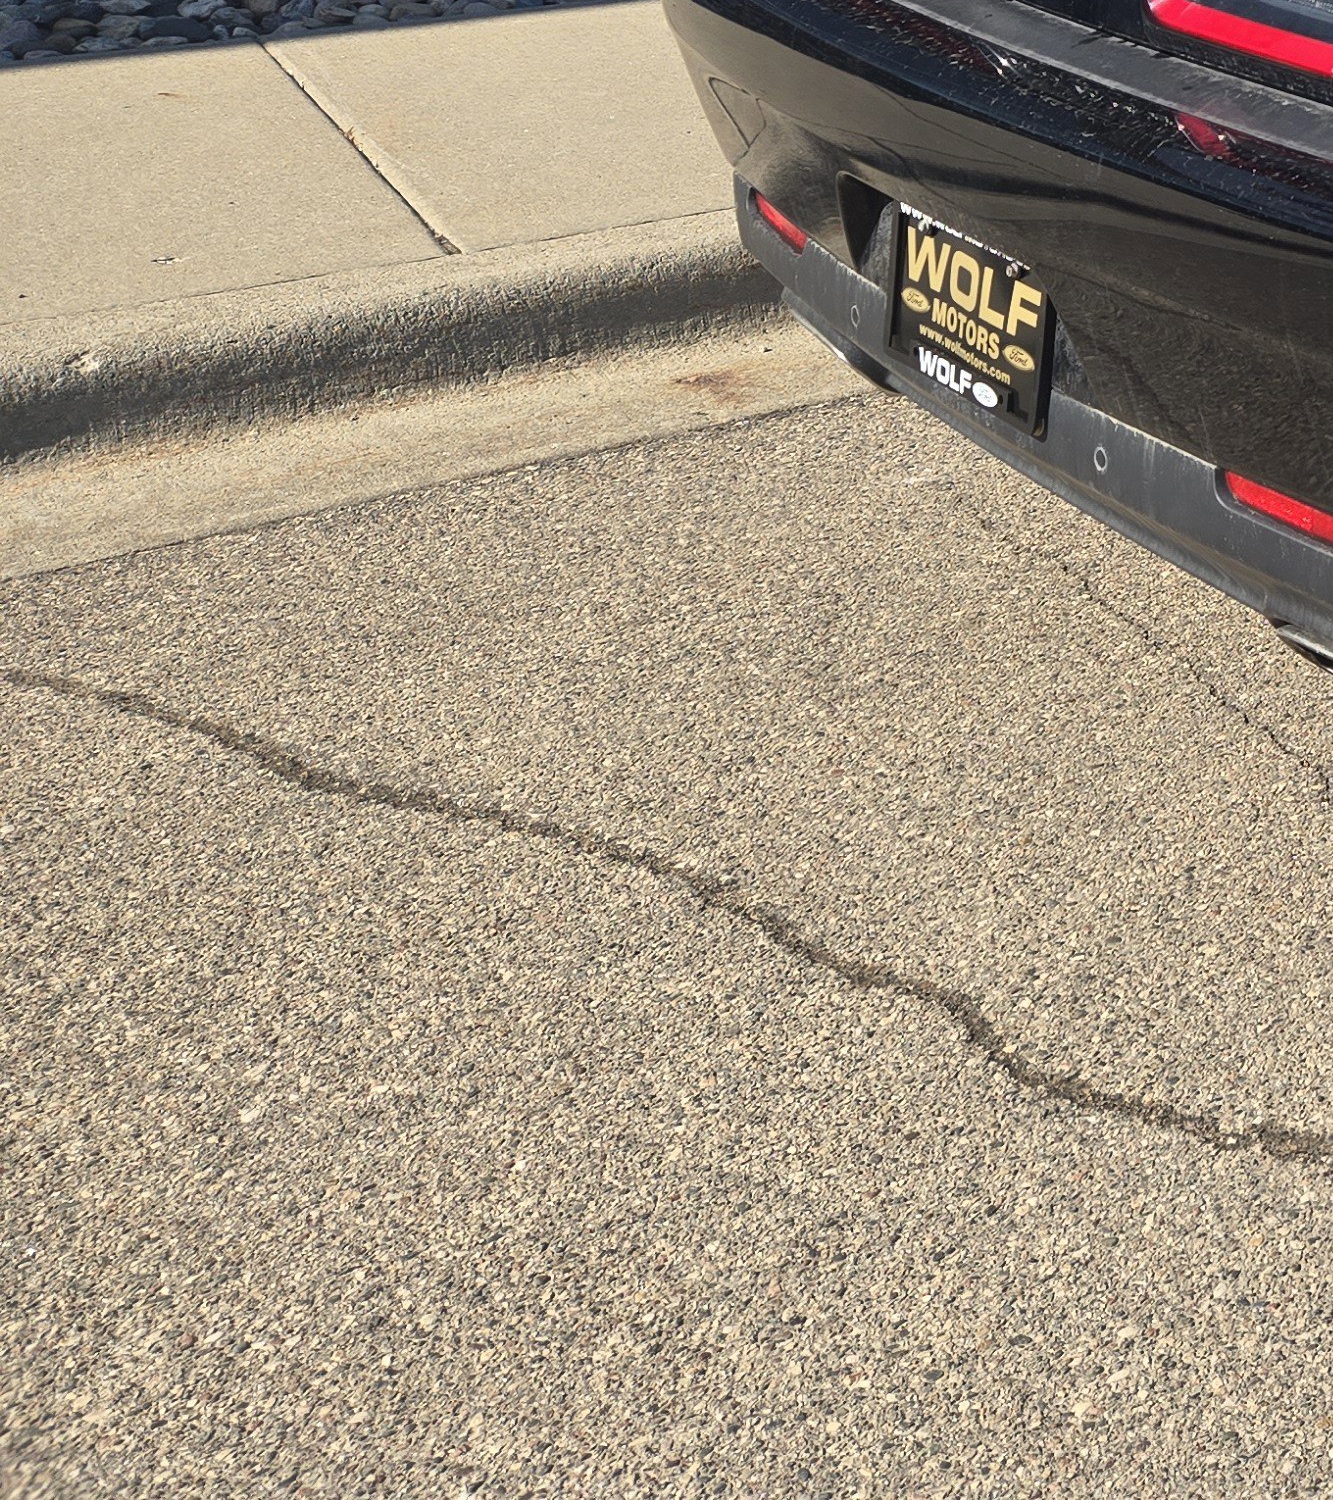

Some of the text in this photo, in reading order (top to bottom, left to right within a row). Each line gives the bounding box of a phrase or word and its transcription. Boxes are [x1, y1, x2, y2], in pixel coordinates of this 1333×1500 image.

[906, 225, 1042, 336] WOLF
[919, 324, 1012, 386] www.wolfmotors.com
[931, 298, 1000, 360] MOTORS
[918, 346, 972, 395] WOLF
